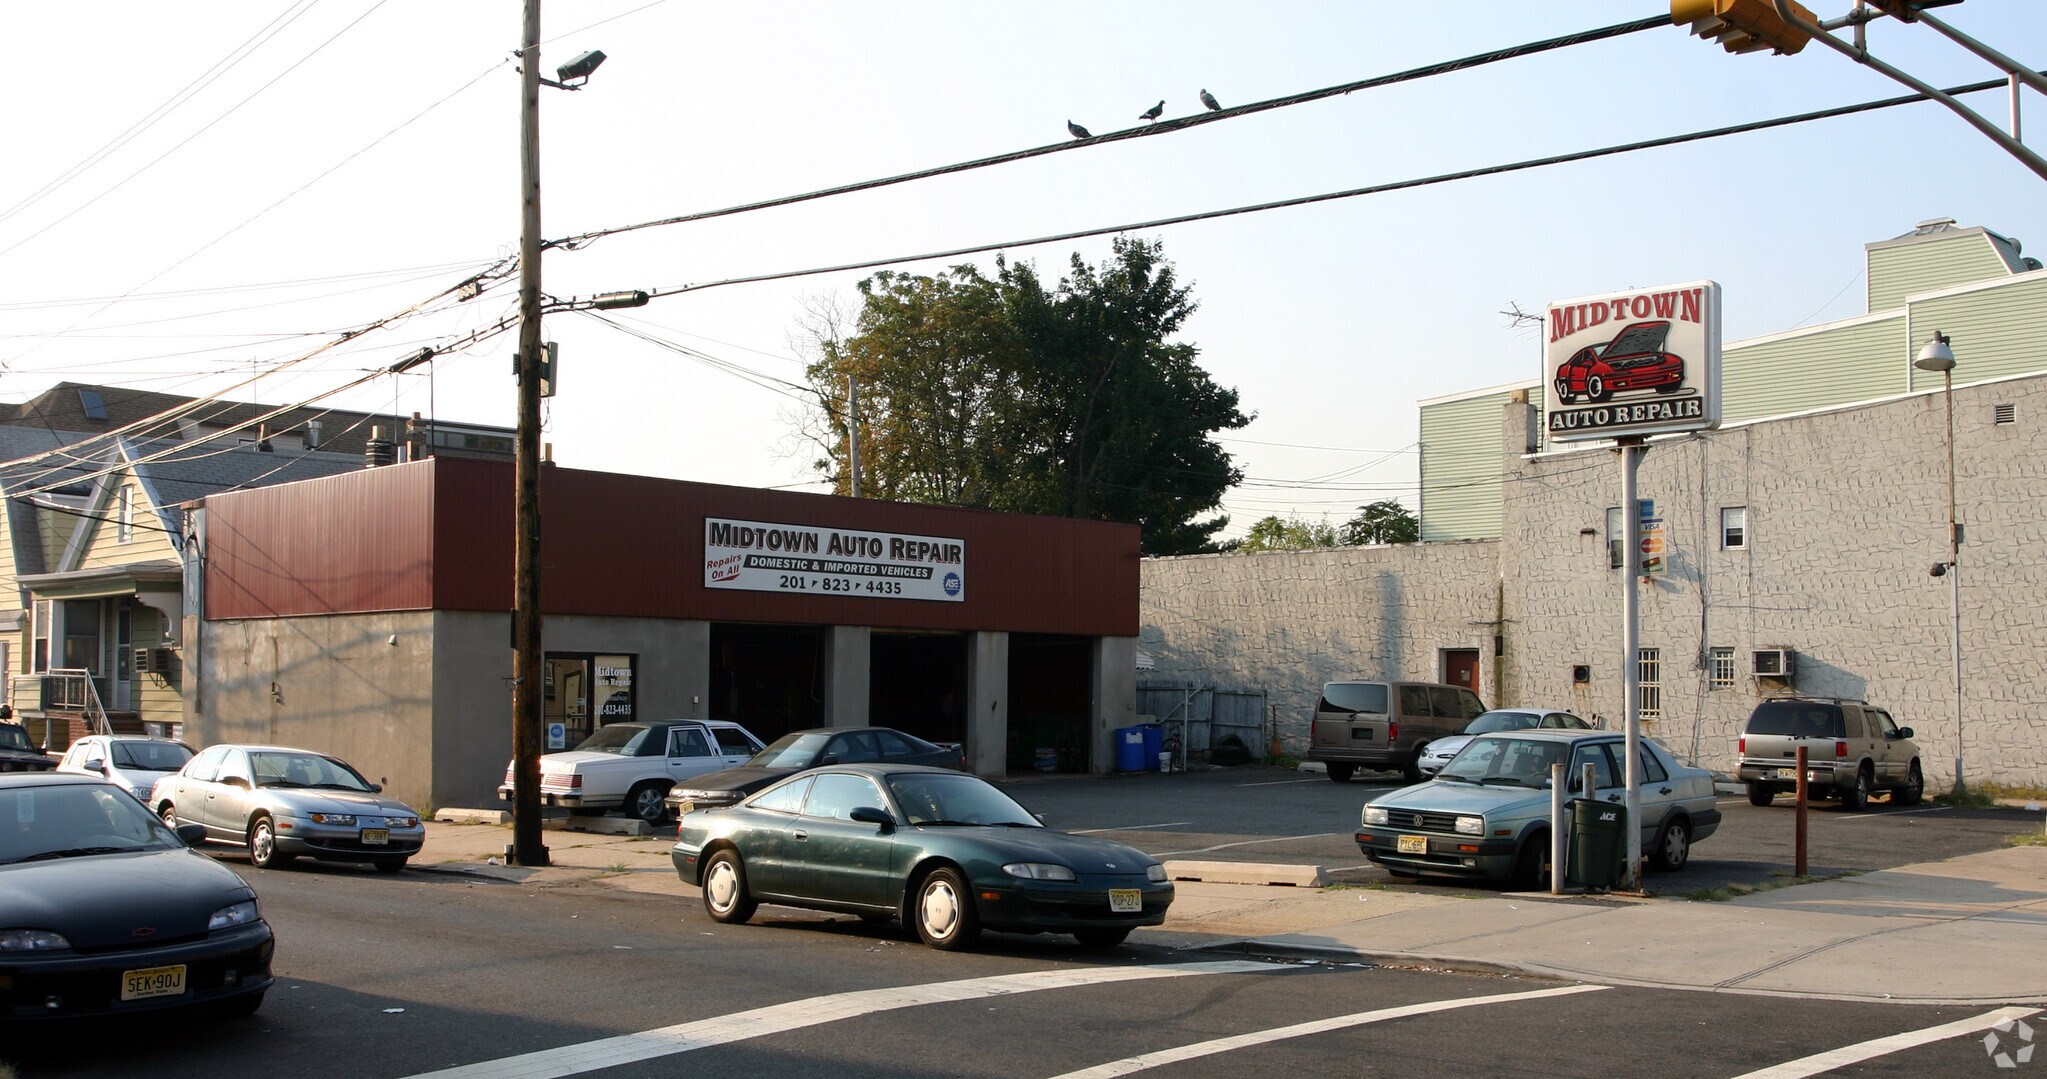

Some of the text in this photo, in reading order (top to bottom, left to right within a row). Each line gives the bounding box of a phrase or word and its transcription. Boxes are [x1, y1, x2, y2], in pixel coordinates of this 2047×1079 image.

[1551, 288, 1702, 343] MIDTOWN
[1551, 400, 1701, 430] AUTO REPAIR
[709, 522, 962, 564] MIDTOWN AUTO REPAIR
[706, 554, 742, 571] Repairs
[750, 557, 928, 578] DOMESTIC & IMPORTED VEHICLES
[711, 564, 740, 580] On All
[779, 575, 901, 594] 201 823 4435
[945, 579, 959, 588] ASE
[594, 666, 632, 677] Midtown
[610, 678, 632, 687] Repair
[1599, 812, 1616, 821] ACE
